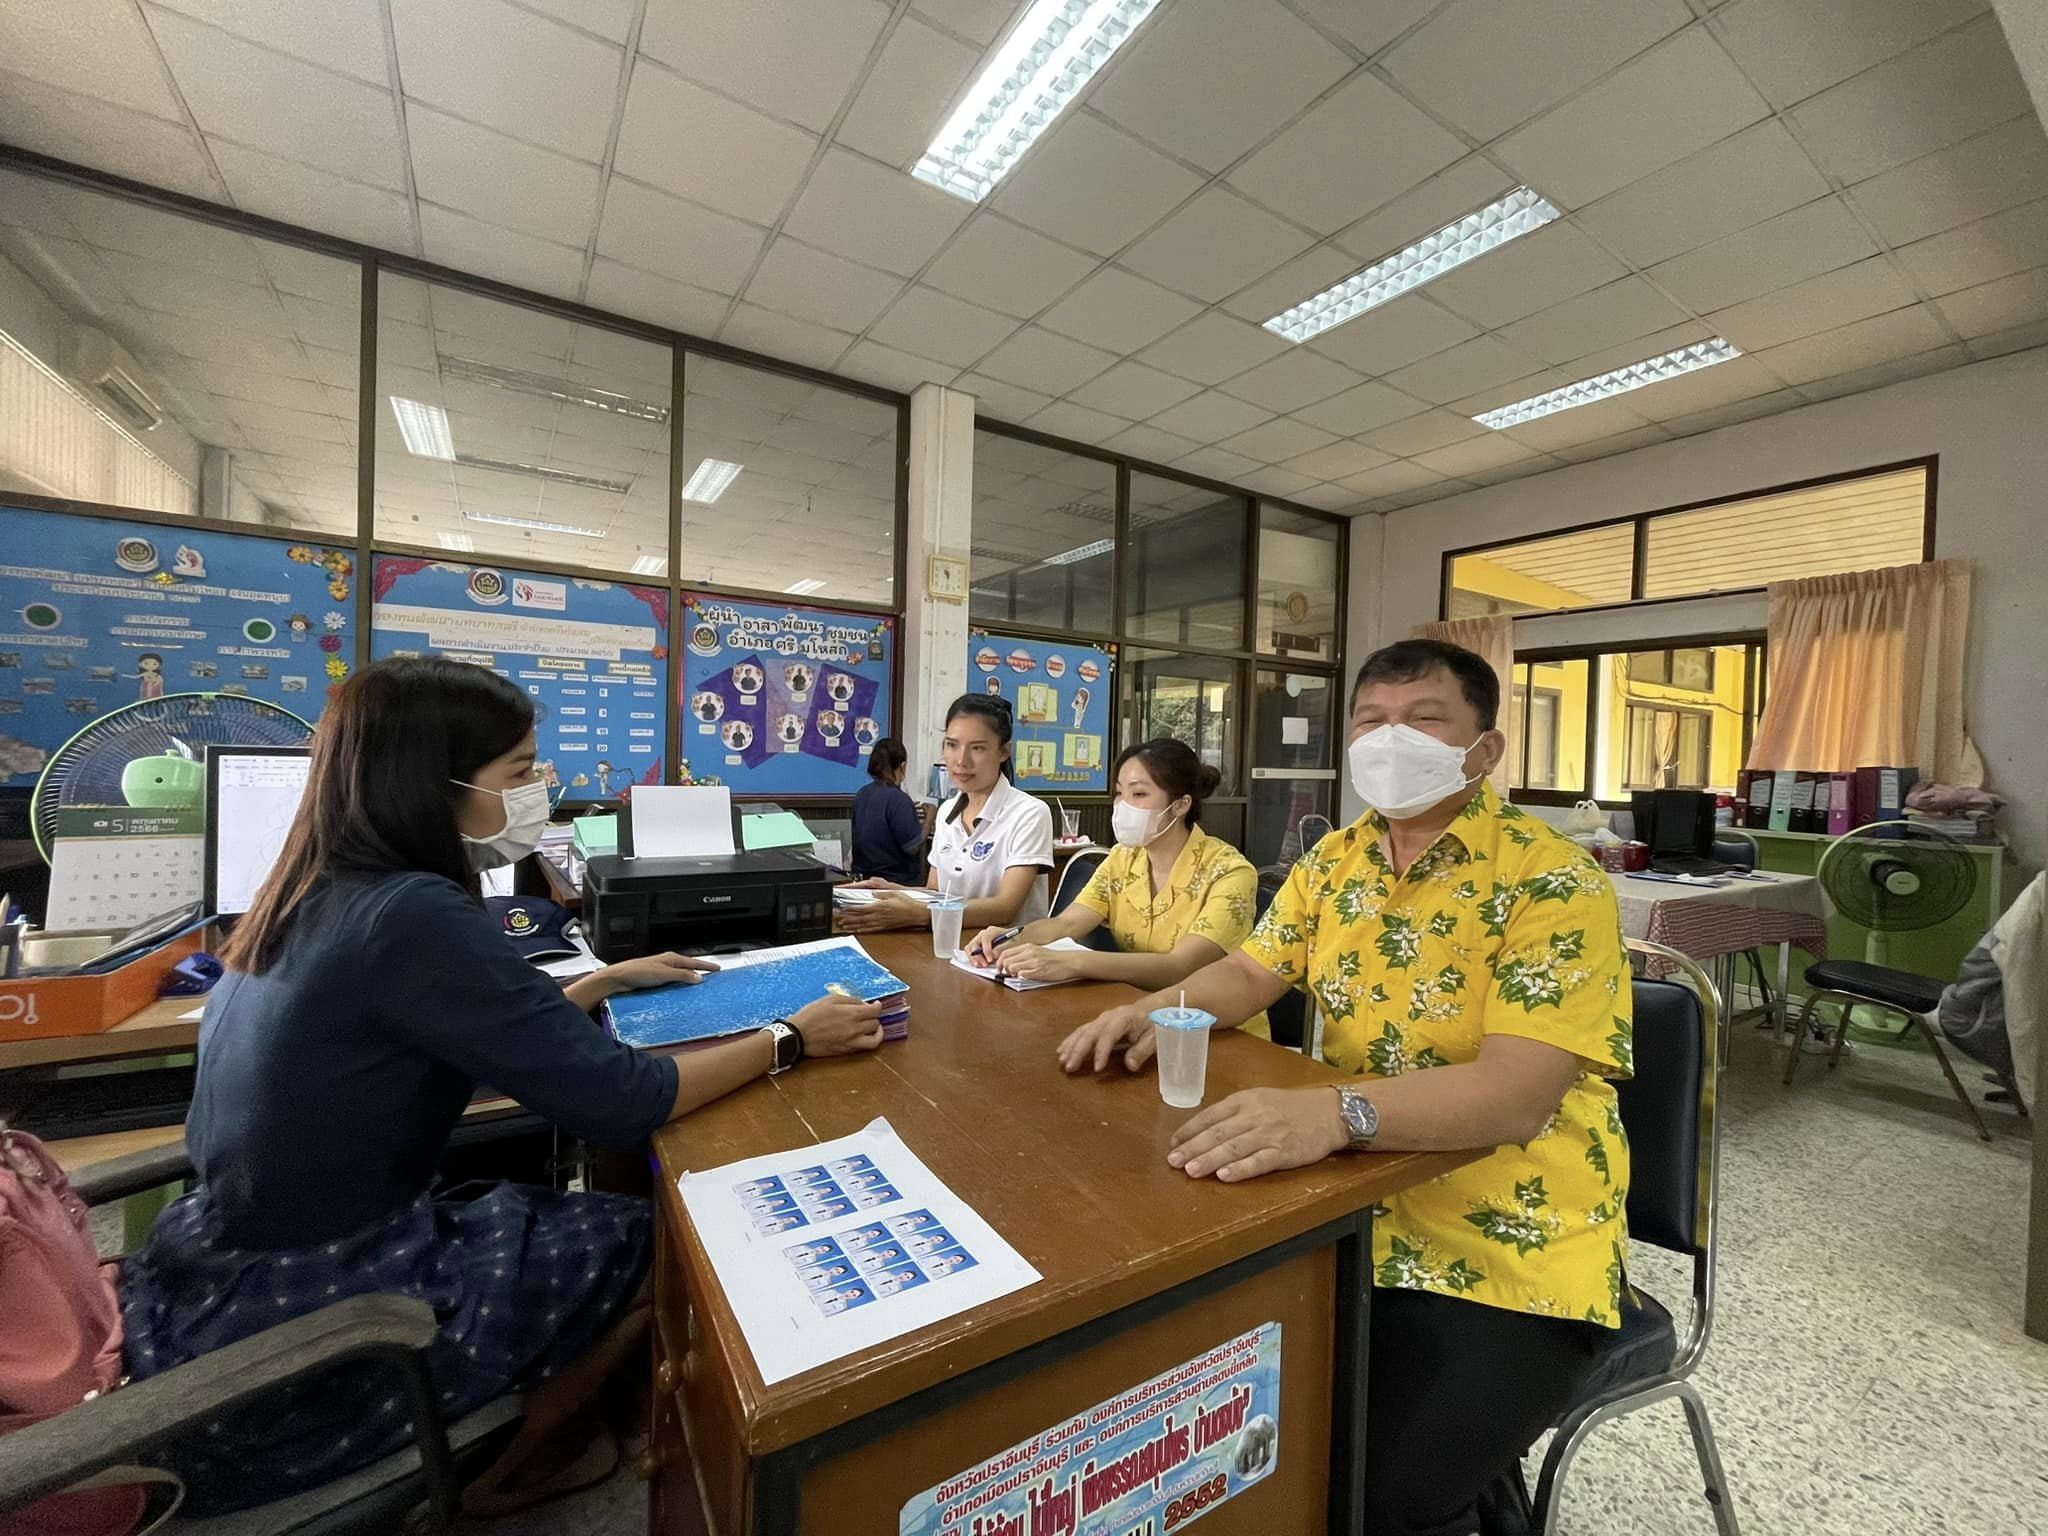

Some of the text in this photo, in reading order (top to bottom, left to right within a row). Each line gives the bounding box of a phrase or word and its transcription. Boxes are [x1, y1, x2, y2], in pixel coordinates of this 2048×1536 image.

[709, 607, 868, 644] ผู้นำ อาสา พัฒนา ชุมชน
[729, 631, 774, 649] อำเภอ
[776, 637, 795, 651] ศรี
[111, 819, 124, 832] 5
[702, 895, 732, 903] Canon
[936, 1330, 1261, 1505] จังหวัดปราจีนบุรี ร่วมกับ องค์การบริหารส่วนจังหวัดปราจีนบุรี
[942, 1446, 1069, 1525] อำเภอเมืองปราจีนบุรี
[1073, 1437, 1095, 1456] และ
[1163, 1472, 1228, 1532] 2552
